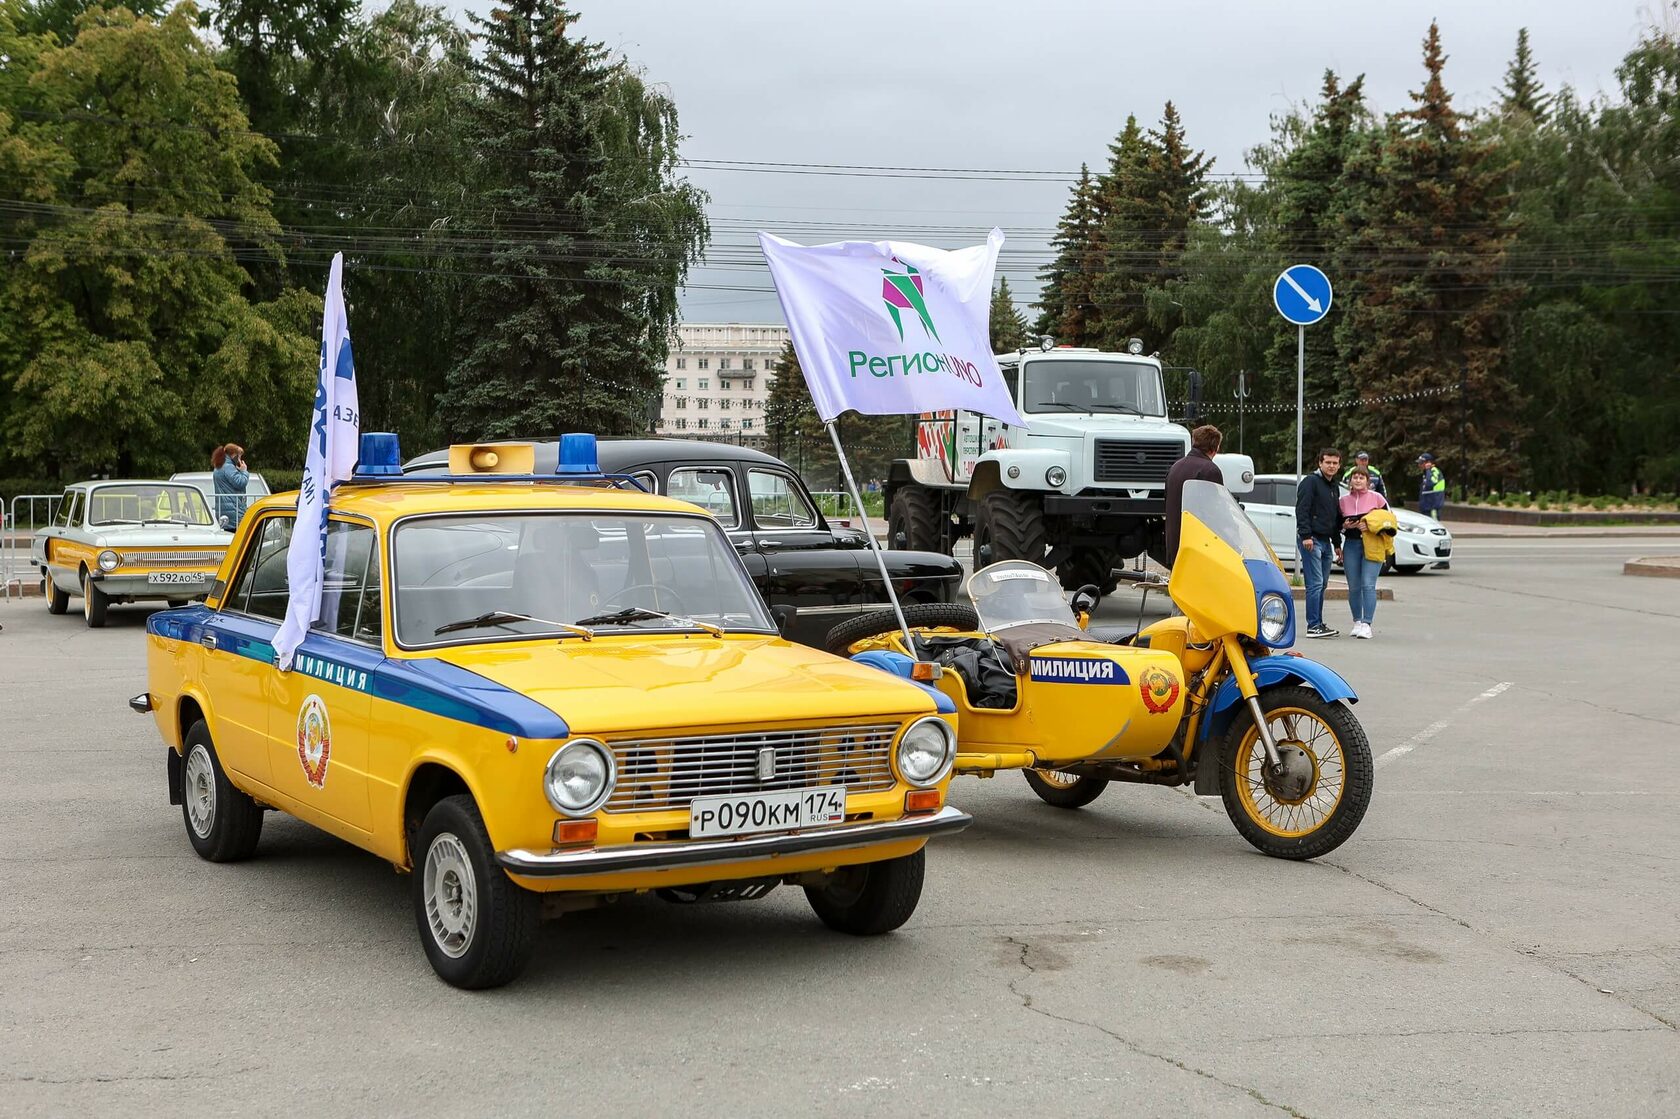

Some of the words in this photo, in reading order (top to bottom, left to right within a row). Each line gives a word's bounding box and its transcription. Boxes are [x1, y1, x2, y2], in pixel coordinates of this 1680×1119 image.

[296, 654, 367, 690] МИЛИЦИЯ
[1031, 659, 1114, 681] МИЛИЦИЯ
[701, 800, 800, 831] Р090КМ
[805, 792, 838, 814] 174
[810, 813, 828, 822] RUS
